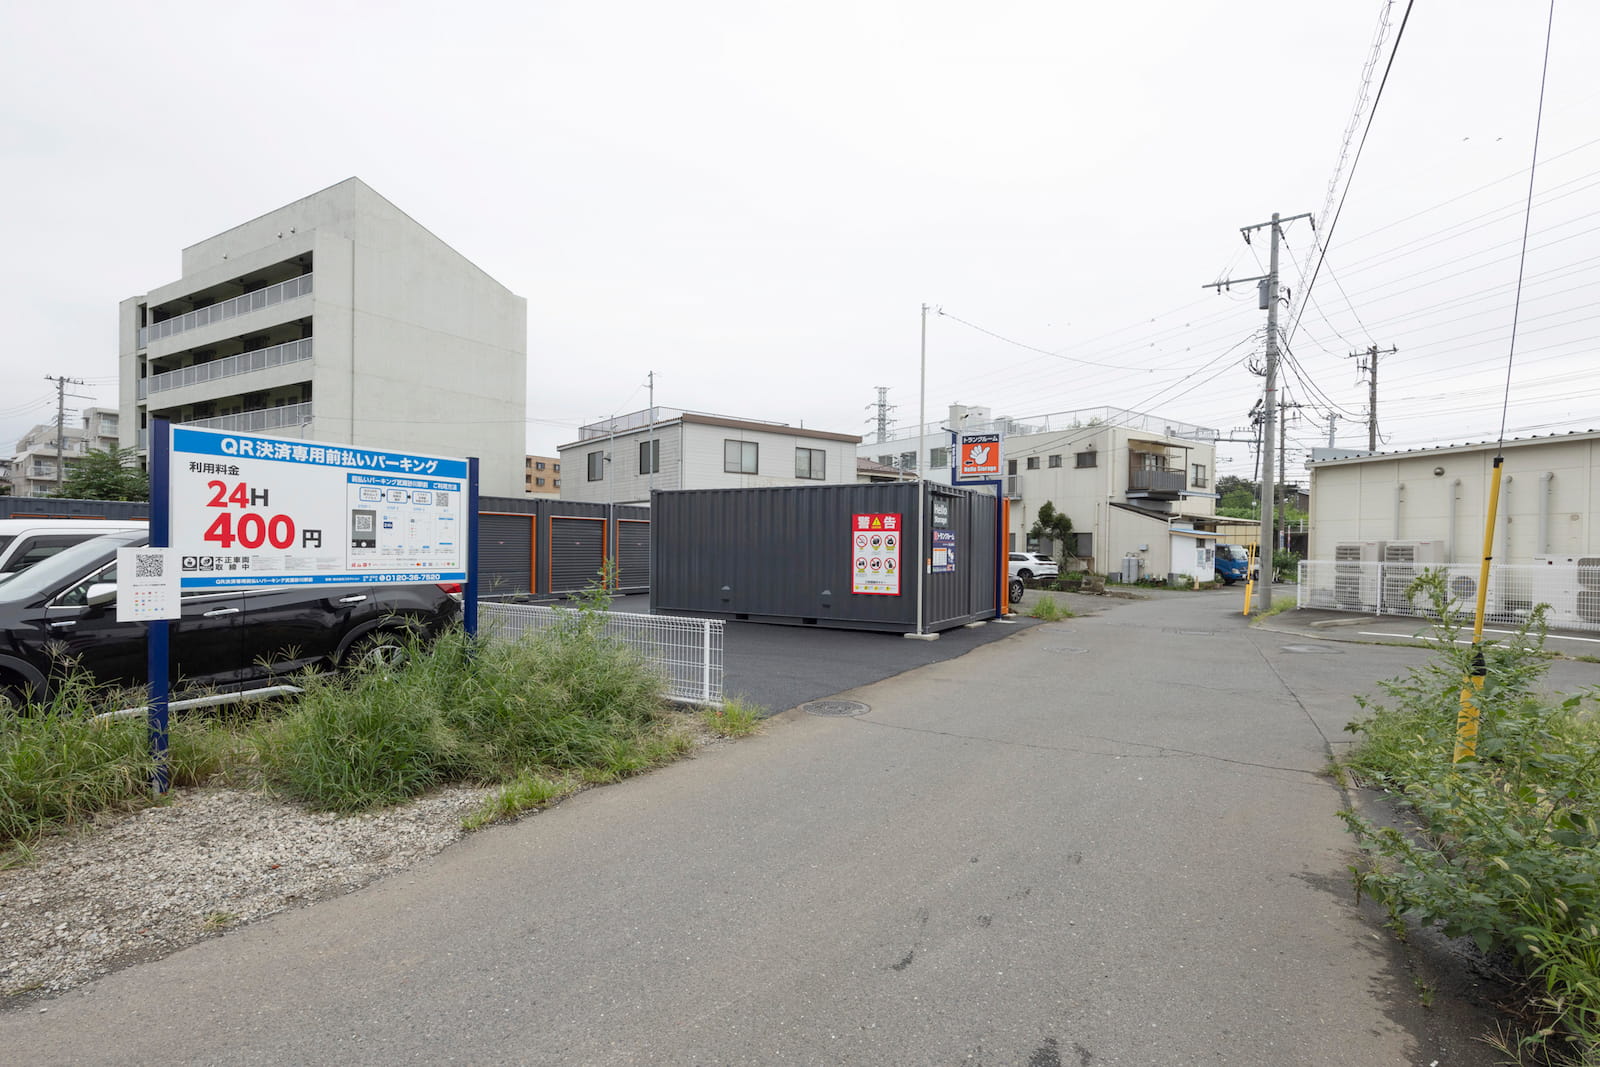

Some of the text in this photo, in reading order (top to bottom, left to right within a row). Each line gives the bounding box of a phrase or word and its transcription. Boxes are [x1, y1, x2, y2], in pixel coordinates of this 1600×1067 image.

[963, 435, 998, 444] トランクルーム
[220, 437, 439, 475] QR決済専用前払いパーキング
[189, 461, 240, 476] 利用料金
[206, 480, 270, 508] 24H
[934, 503, 948, 515] Hello
[203, 512, 322, 550] 400 円
[215, 556, 250, 564] 不正車両
